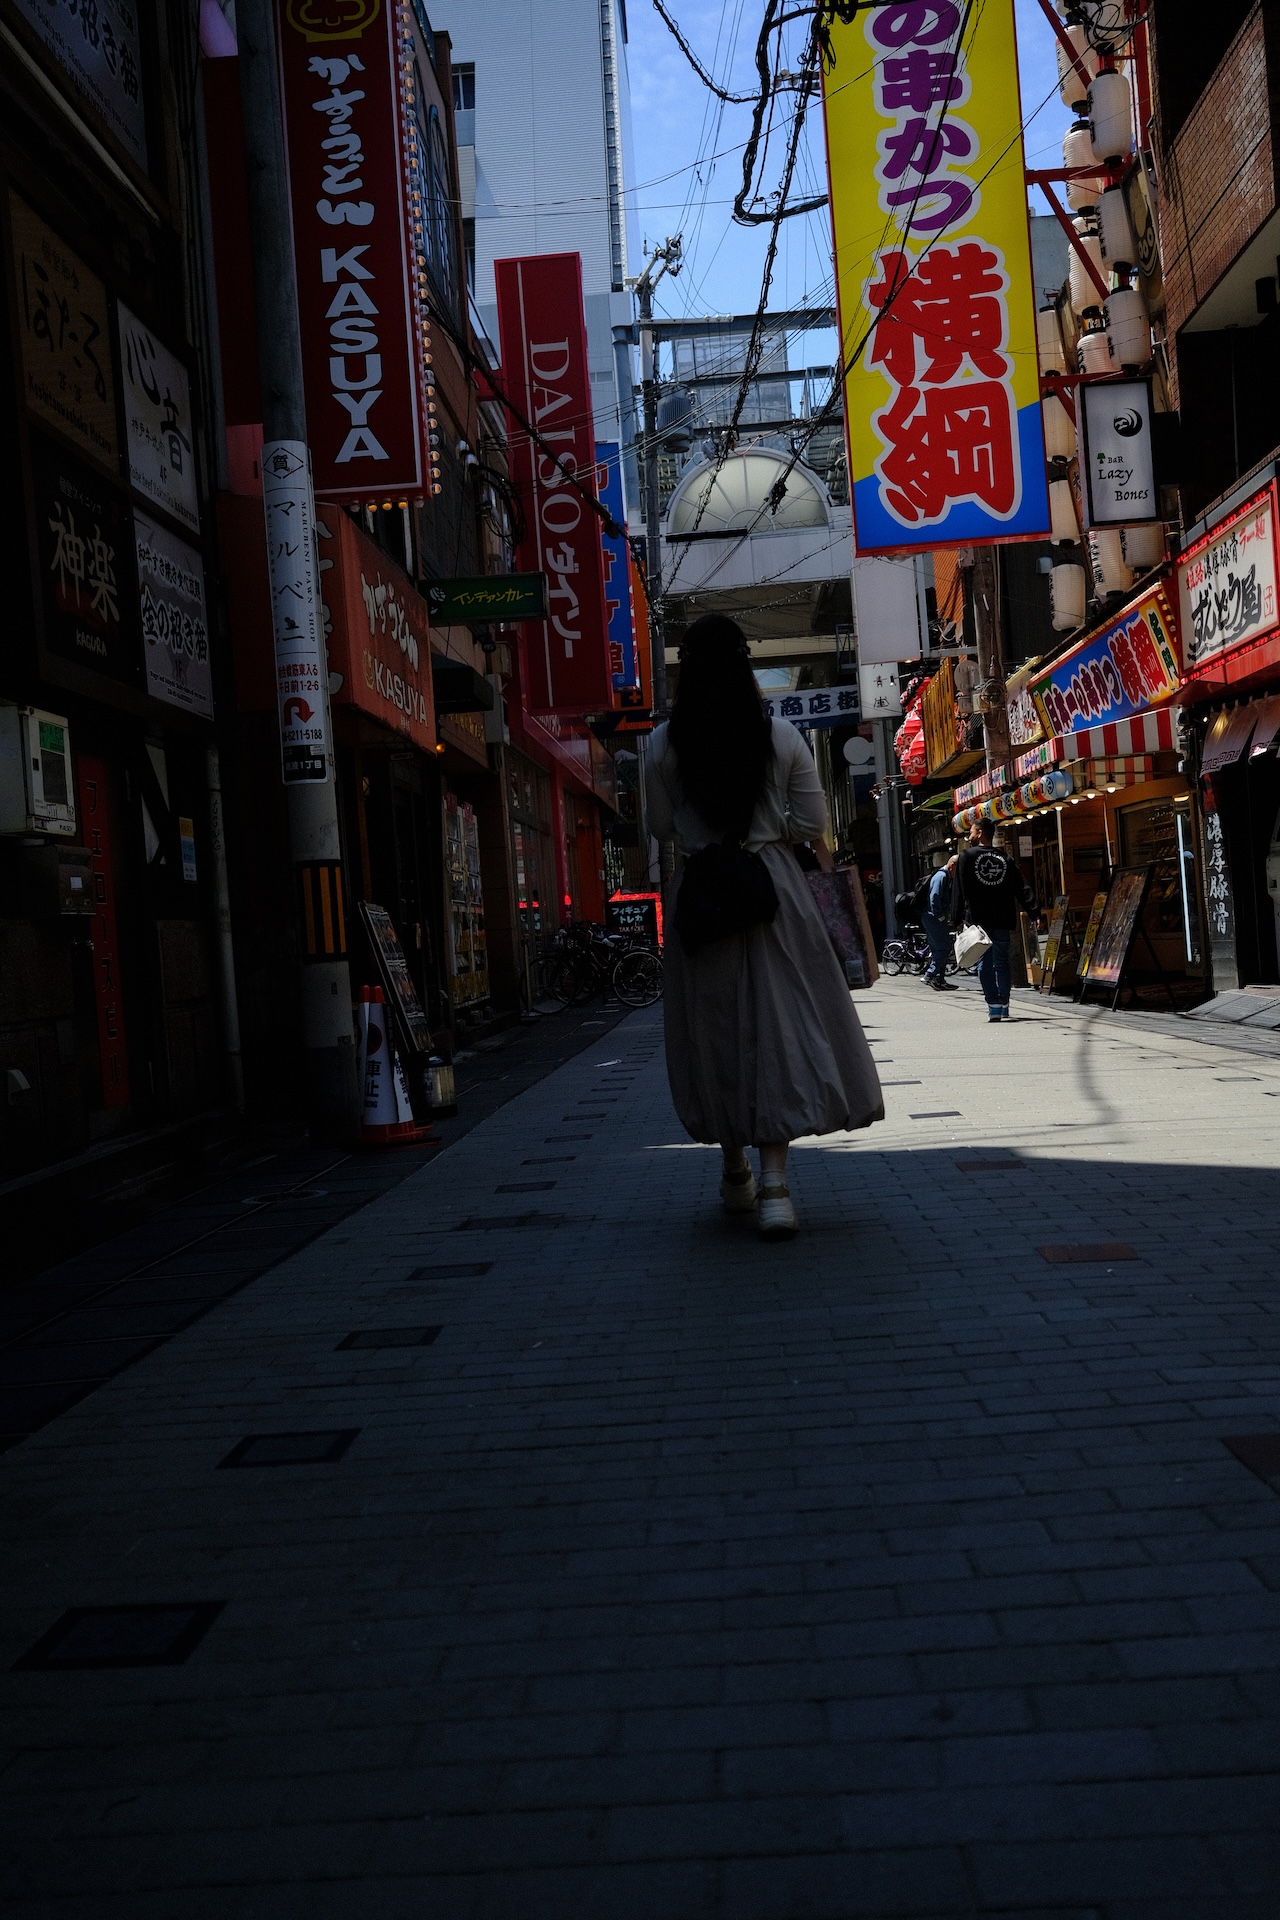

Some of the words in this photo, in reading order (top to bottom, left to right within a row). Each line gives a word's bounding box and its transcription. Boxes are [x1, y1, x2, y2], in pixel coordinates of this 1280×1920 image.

[306, 53, 376, 227] かすうどん
[20, 250, 107, 405] ほたる
[319, 243, 391, 465] KASUYA
[868, 243, 1015, 522] 横綱
[125, 327, 191, 476] 心音
[529, 336, 582, 534] DAISO
[1098, 469, 1134, 487] Lazy
[1114, 489, 1149, 502] Bones
[48, 501, 121, 624] 神楽
[305, 570, 314, 604] PAWN
[545, 541, 581, 659] ダイソー
[76, 628, 108, 657] KAGURA
[373, 658, 428, 728] KASUYA
[1044, 659, 1120, 736] 日本一の串かつ
[1109, 617, 1168, 704] 横綱
[611, 904, 649, 916] フィギュア
